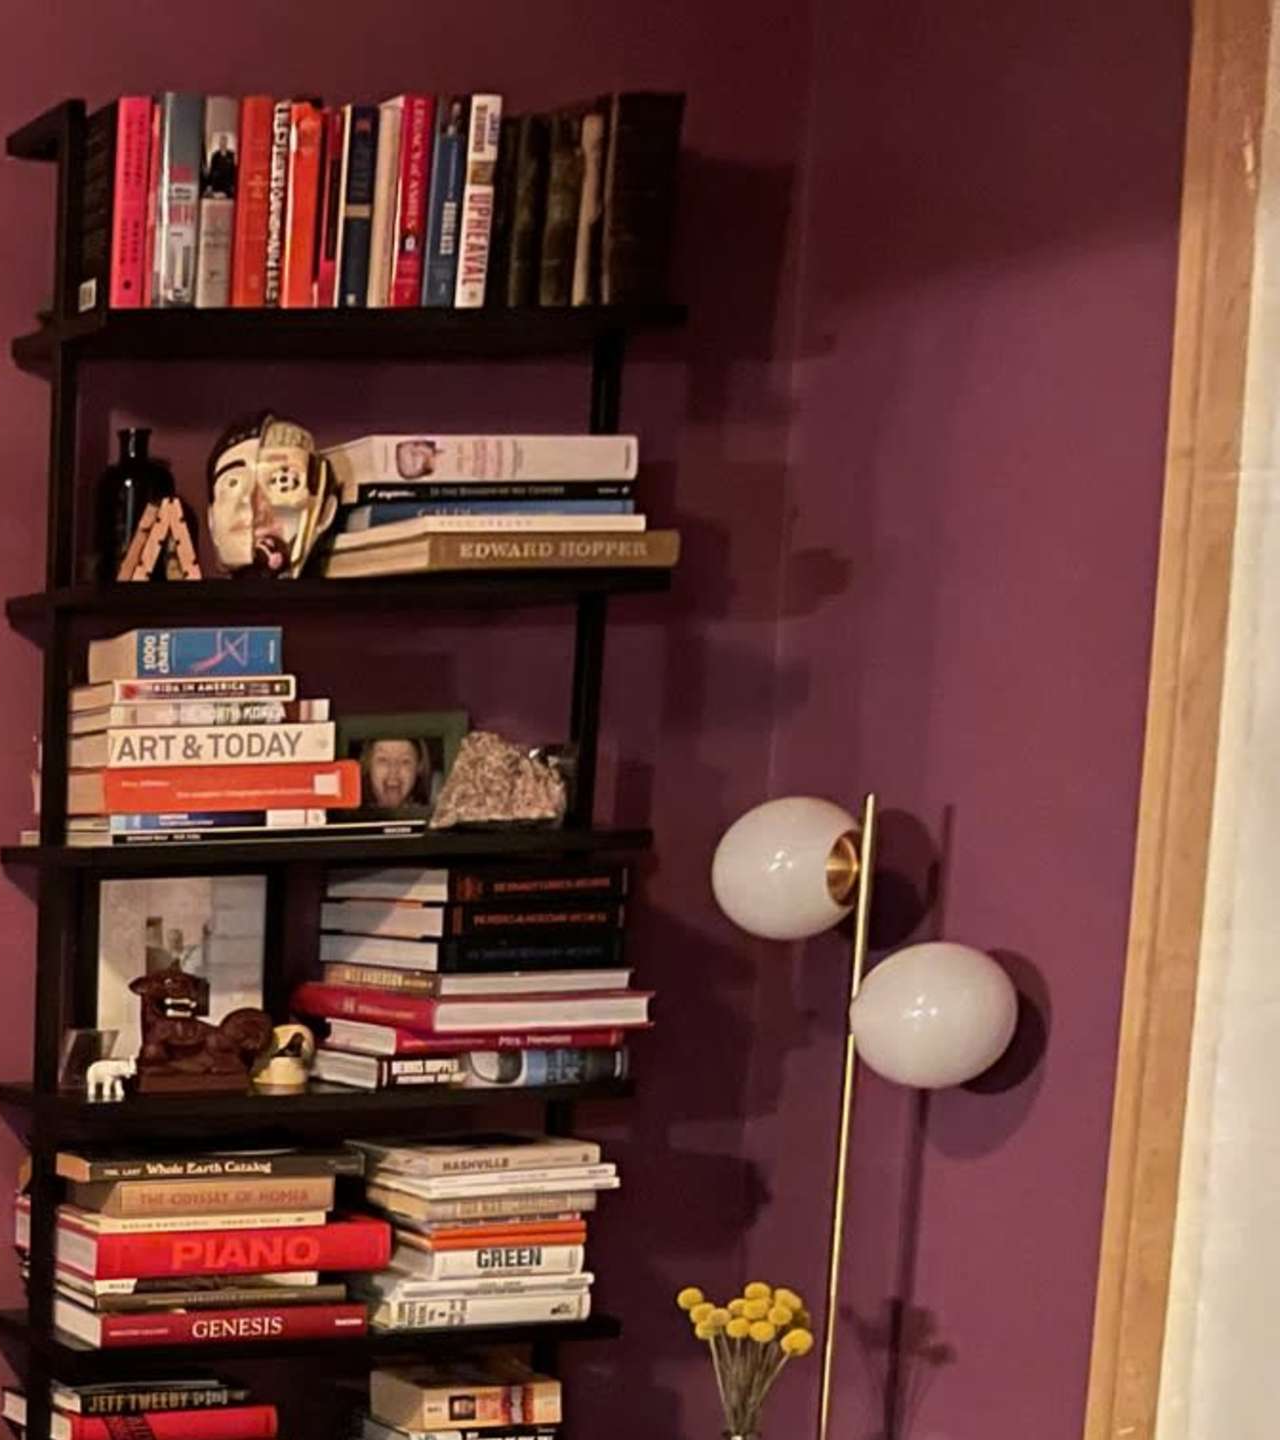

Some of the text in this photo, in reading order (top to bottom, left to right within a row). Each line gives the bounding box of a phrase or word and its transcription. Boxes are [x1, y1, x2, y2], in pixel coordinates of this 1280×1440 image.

[462, 193, 493, 287] UPHEAVAL
[458, 539, 648, 560] EDWARD HOPPER
[116, 730, 304, 762] ART & TODAY
[146, 1163, 184, 1175] Whole
[187, 1162, 223, 1174] Earth
[225, 1160, 272, 1174] Catalog
[442, 1157, 510, 1171] NASHVILLE
[171, 1235, 321, 1271] PIANO
[476, 1247, 543, 1269] GREEN
[192, 1315, 284, 1339] GENESIS
[89, 1391, 189, 1412] JEFF TWEEDY
